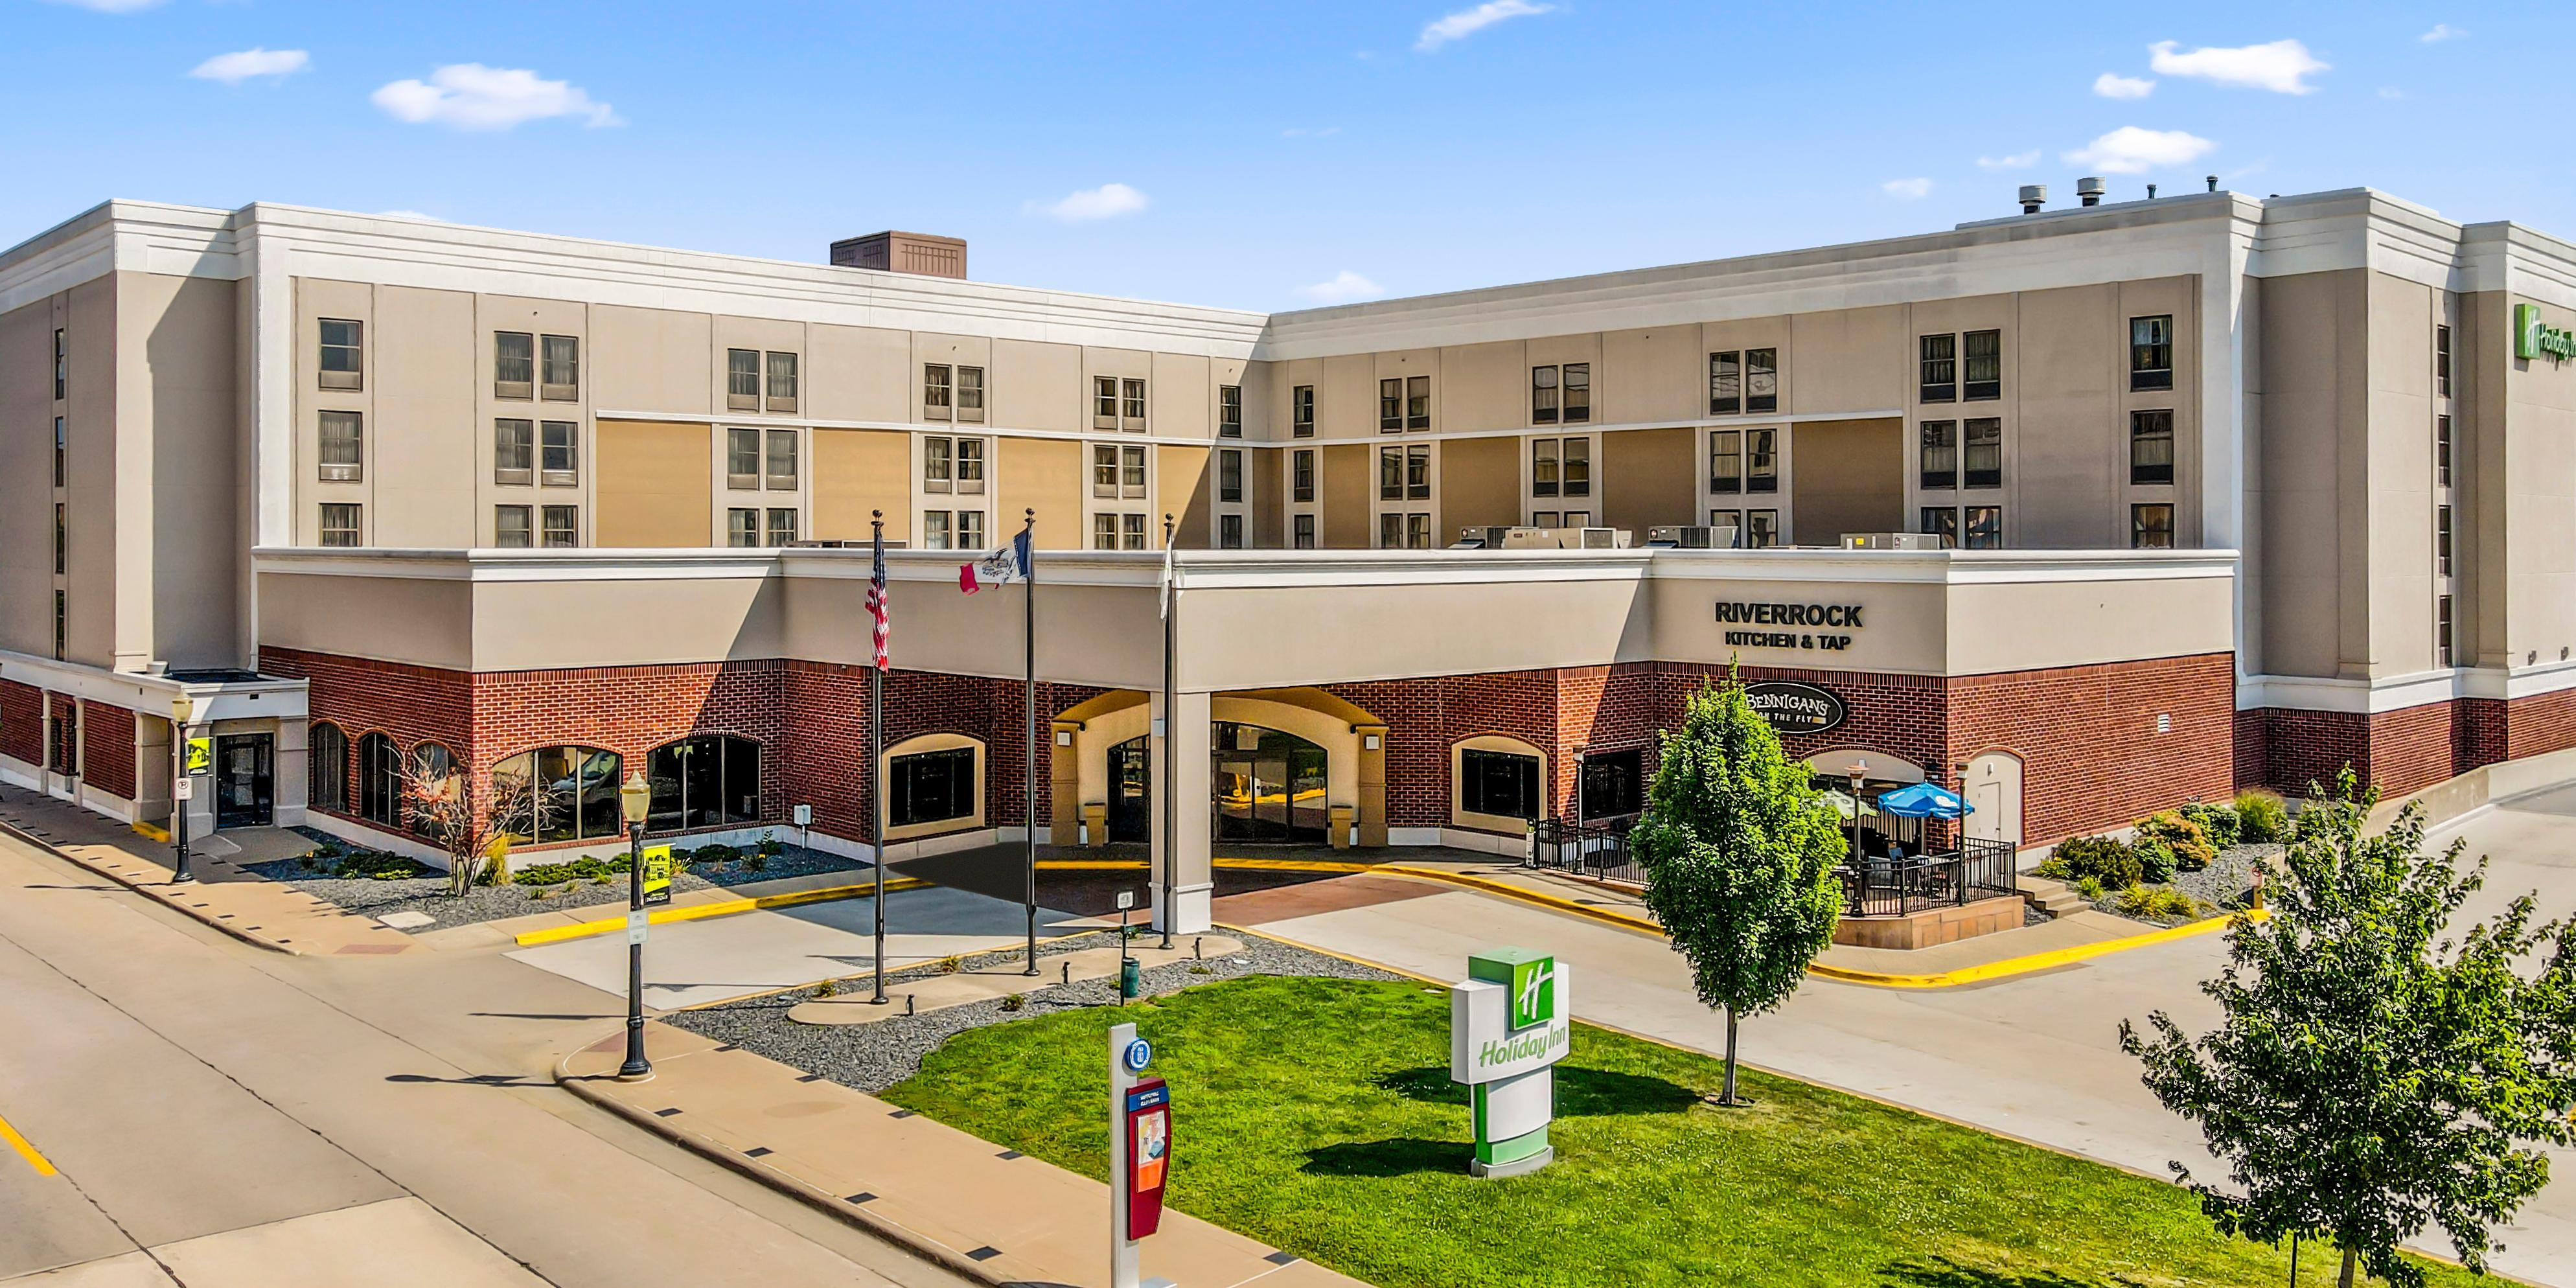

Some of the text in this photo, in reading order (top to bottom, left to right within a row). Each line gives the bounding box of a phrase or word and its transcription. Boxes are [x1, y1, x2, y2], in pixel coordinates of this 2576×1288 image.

[2540, 323, 2570, 361] Holiday
[1716, 602, 1863, 627] RIVERROCK
[1725, 631, 1851, 650] KITCHEN & TAP
[1745, 693, 1828, 717] BENNIGAN'S
[1775, 713, 1791, 721] THE
[1796, 715, 1812, 723] FLY
[1479, 1024, 1566, 1068] Holiday Inn
